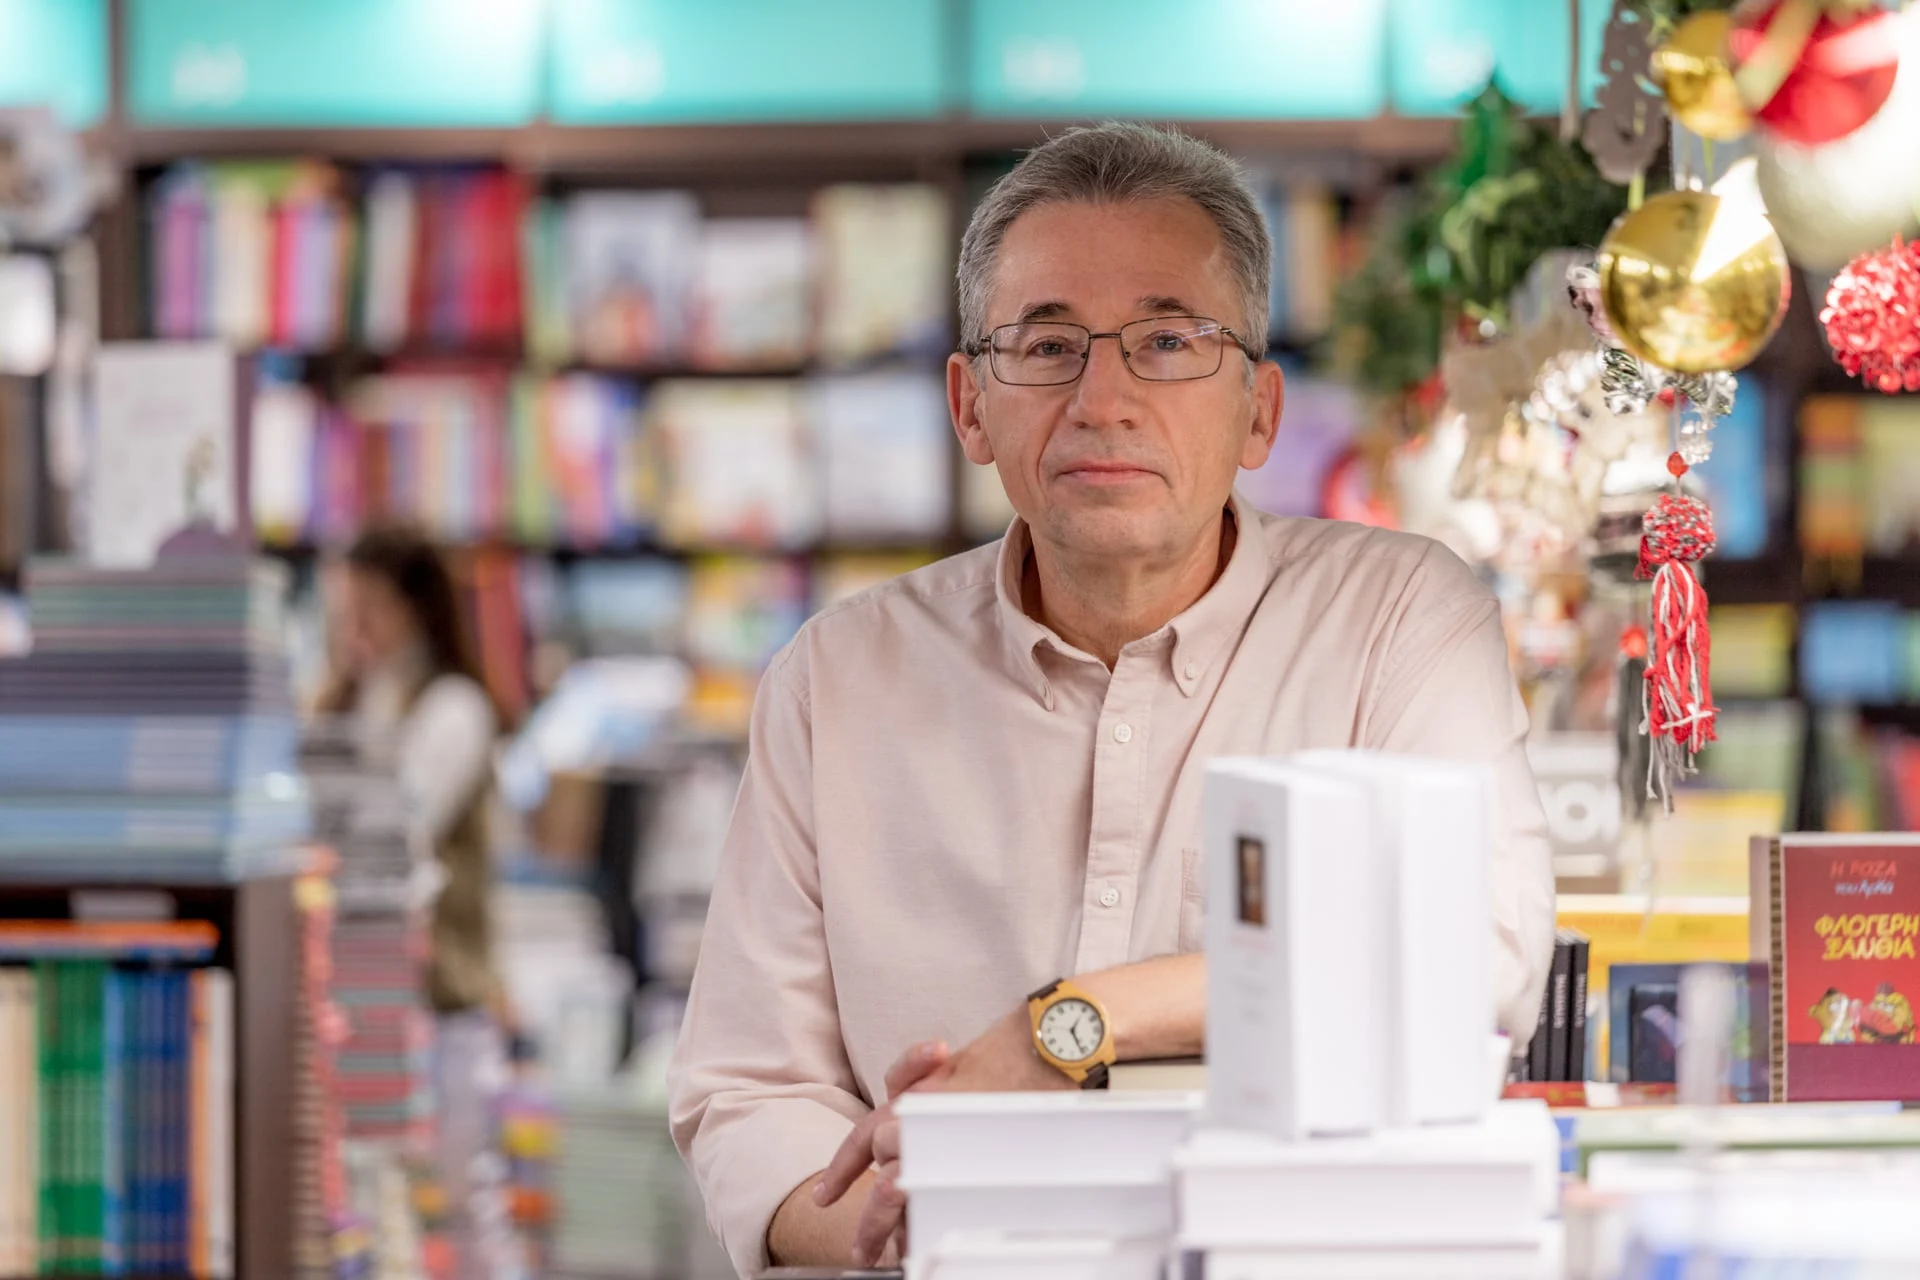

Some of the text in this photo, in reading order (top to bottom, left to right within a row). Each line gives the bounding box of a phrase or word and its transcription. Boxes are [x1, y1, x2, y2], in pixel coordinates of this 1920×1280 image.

[1830, 859, 1897, 879] Η ΡΟΖΑ
[1814, 912, 1920, 937] ΦΛΟΓΕΡΗ
[1821, 935, 1916, 960] ΞΑΝΘΙΑ
